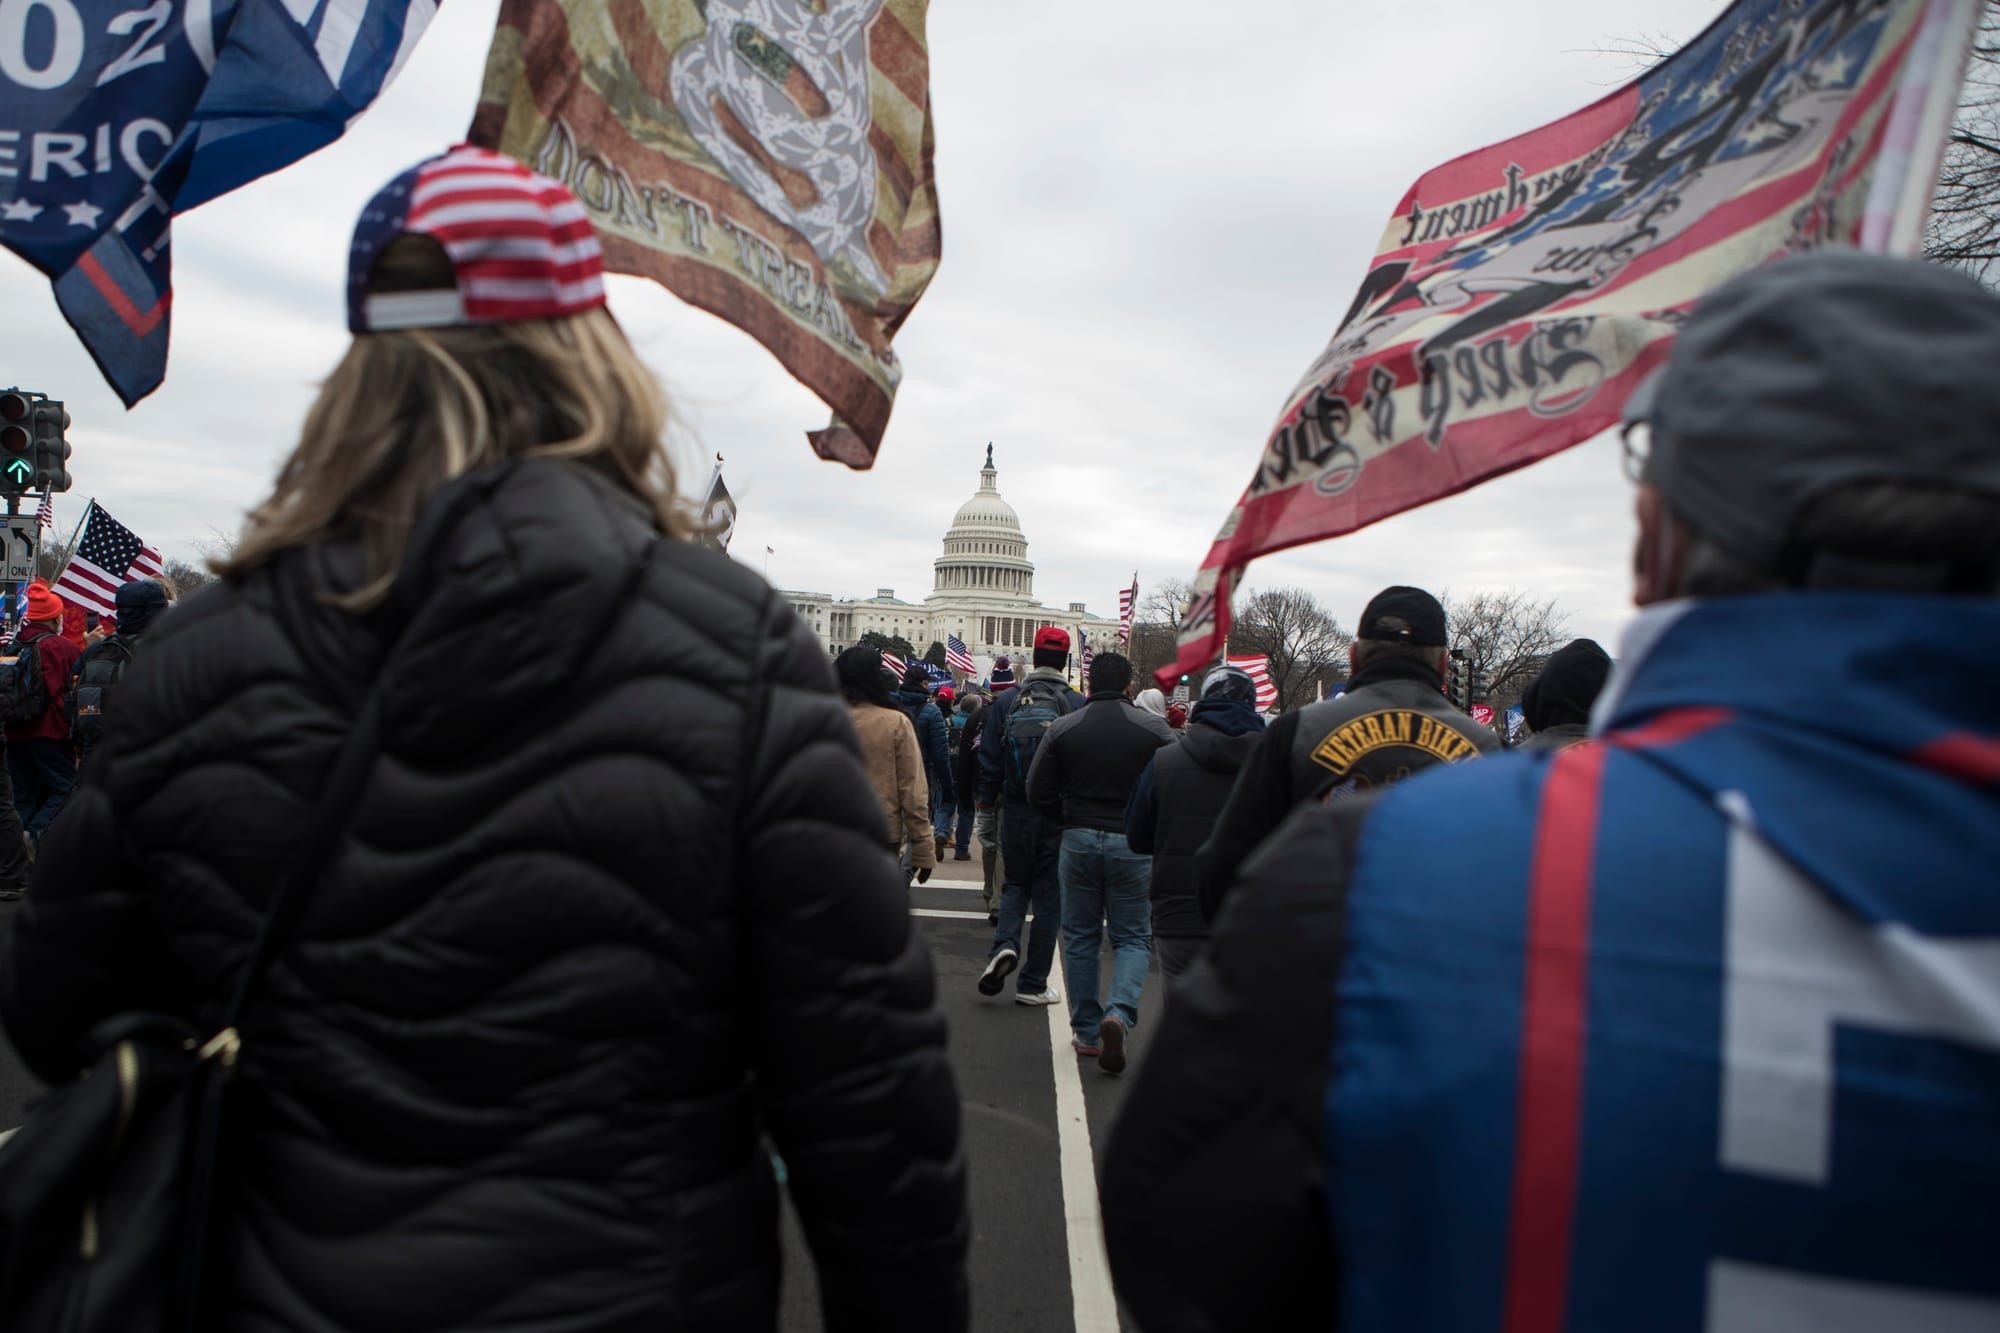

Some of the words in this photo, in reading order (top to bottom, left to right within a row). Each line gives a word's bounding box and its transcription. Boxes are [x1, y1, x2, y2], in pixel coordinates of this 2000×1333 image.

[11, 566, 33, 576] ONLY
[1319, 712, 1413, 768] VETERAN
[1415, 717, 1478, 763] BIKE
